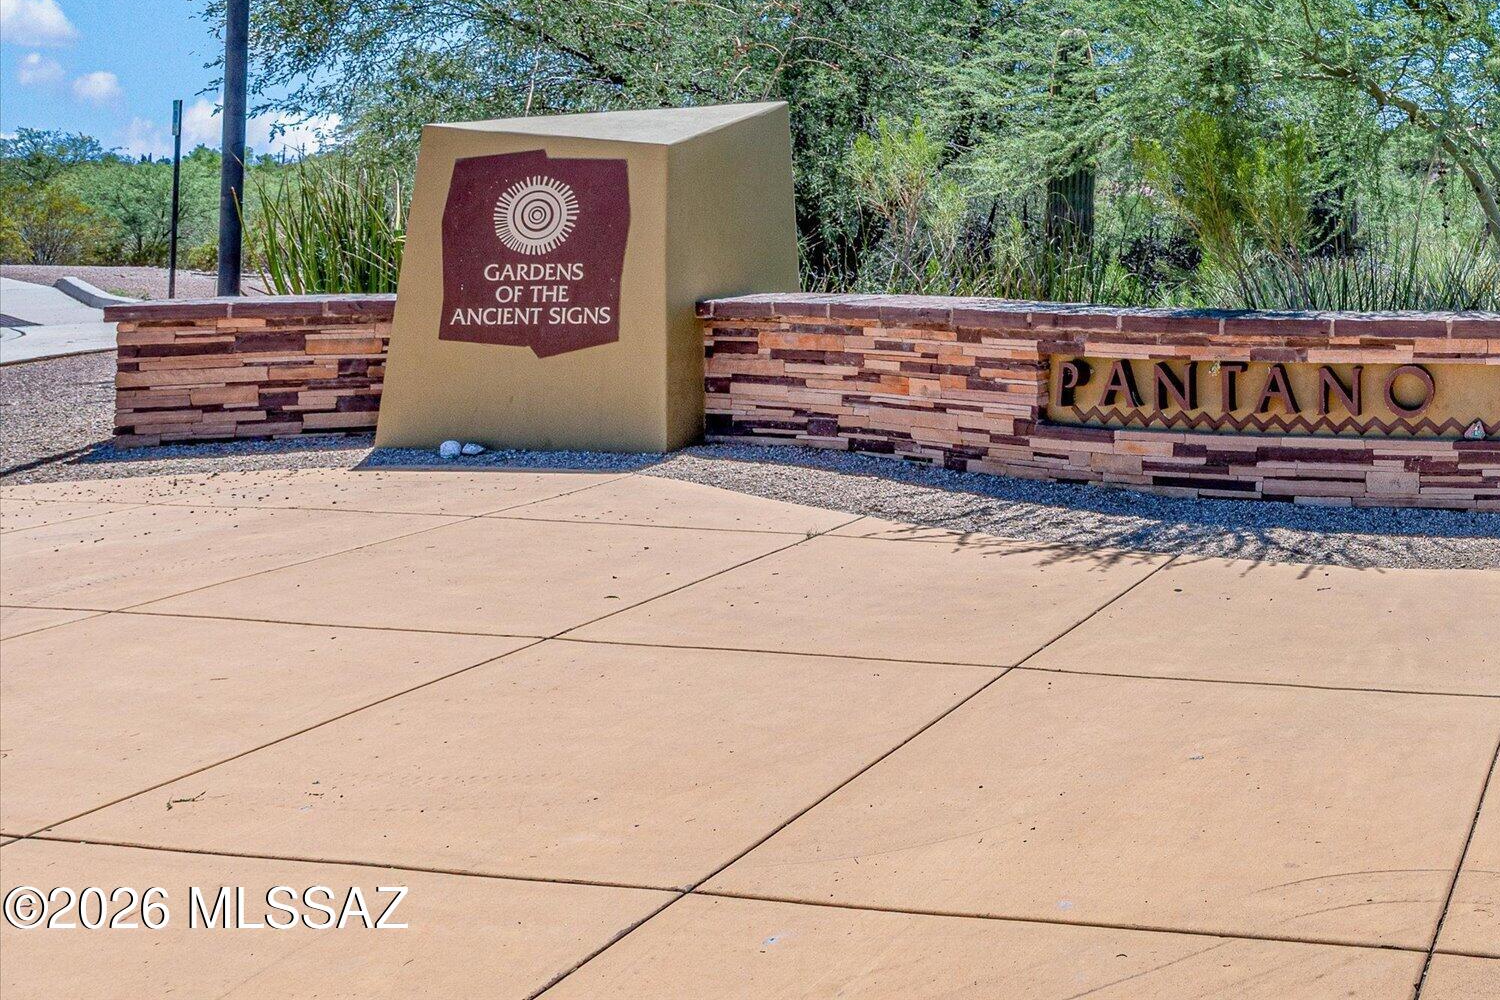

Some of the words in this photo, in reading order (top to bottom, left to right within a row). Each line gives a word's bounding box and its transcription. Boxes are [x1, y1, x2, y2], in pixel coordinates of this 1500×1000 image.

[484, 263, 584, 281] GARDENS
[495, 286, 524, 303] OF
[531, 286, 569, 303] THE
[450, 307, 543, 326] ANCIENT
[548, 306, 611, 325] SIGNS
[1056, 358, 1436, 418] PANTANO
